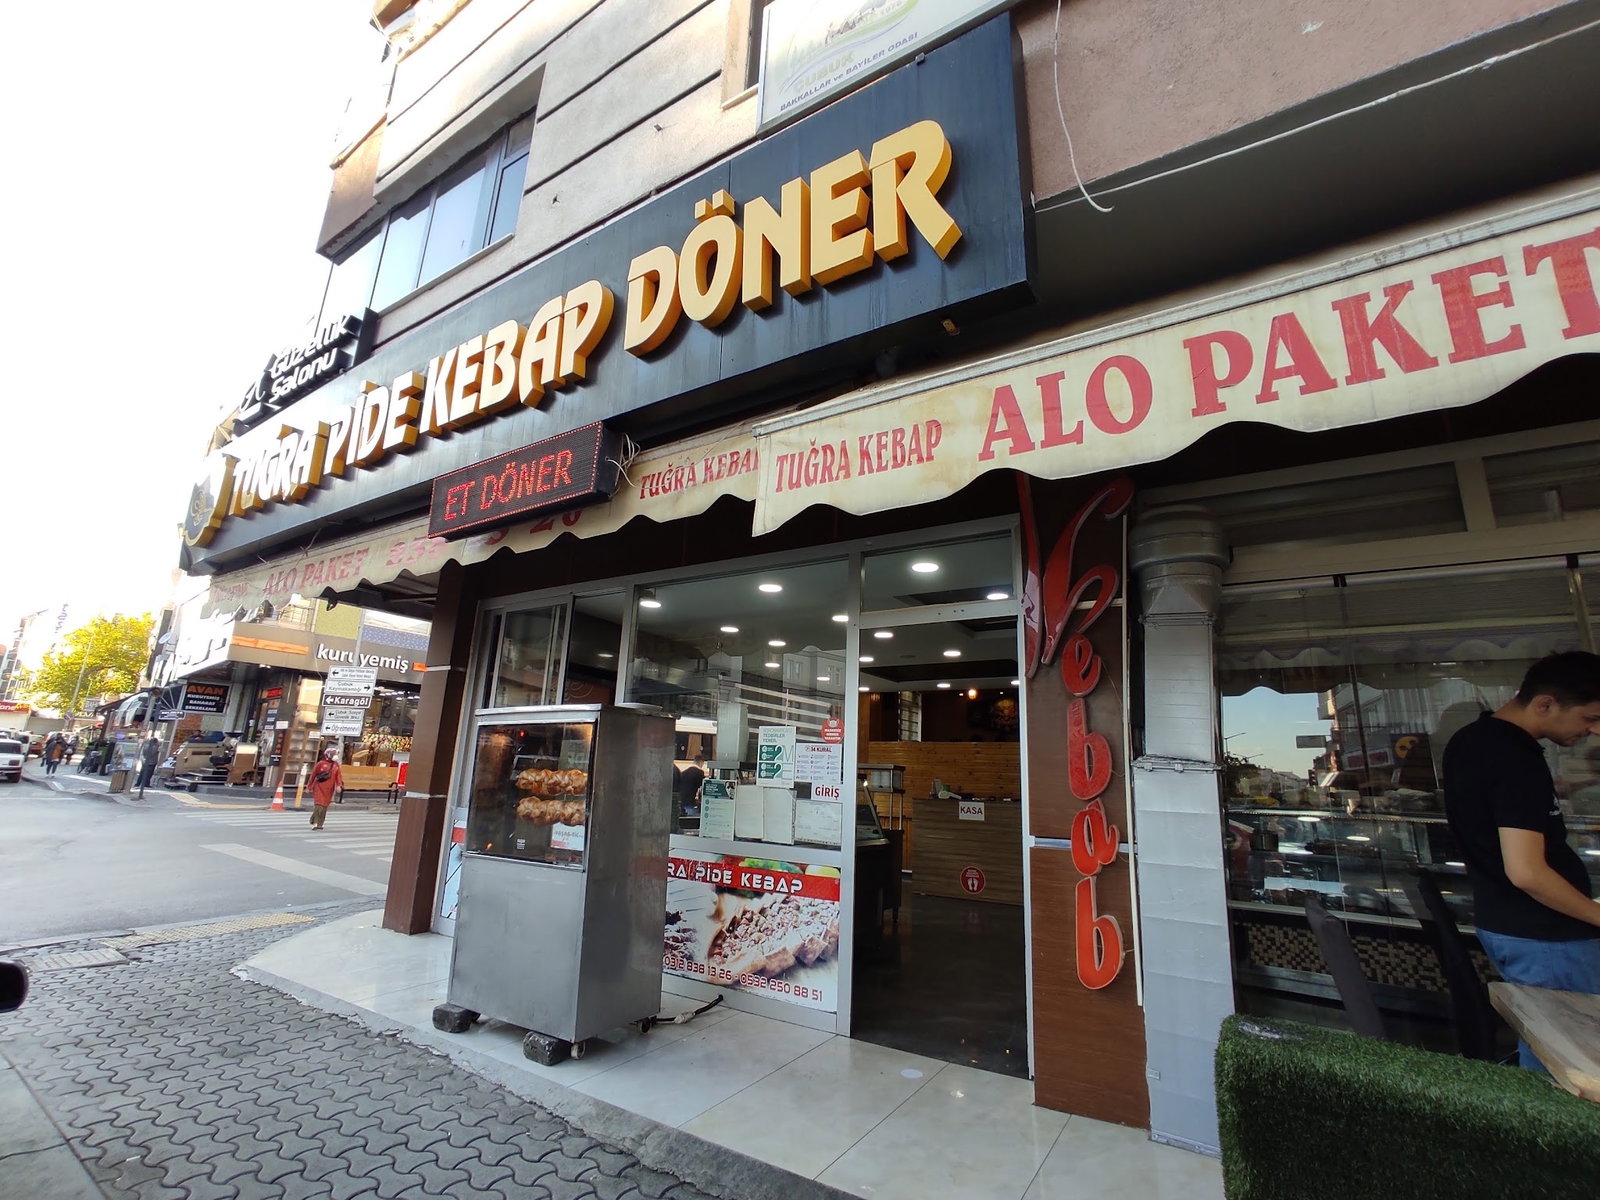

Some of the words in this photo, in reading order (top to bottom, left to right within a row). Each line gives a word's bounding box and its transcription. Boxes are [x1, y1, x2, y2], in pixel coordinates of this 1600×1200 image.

[780, 79, 832, 112] BAKKALLAR
[833, 73, 844, 82] ve
[845, 49, 886, 76] BAYİLER
[887, 32, 919, 53] ODASI
[323, 371, 430, 477] PİDE
[420, 280, 609, 436] KEBAP
[624, 119, 961, 356] DÖNER
[978, 355, 1153, 462] ALO
[1183, 225, 1600, 418] PAKET
[775, 438, 852, 493] TUĞRA
[857, 418, 943, 477] KEBAP
[443, 479, 476, 522] ET
[479, 448, 574, 511] DÖNER
[638, 462, 698, 500] TUĞRA
[261, 568, 297, 598] ALO
[300, 547, 370, 589] PAKET
[187, 685, 224, 696] AVAN
[333, 696, 369, 707] Karagöl
[815, 785, 840, 800] GİRİŞ
[960, 806, 983, 815] KASA
[695, 862, 733, 884] PİDE
[741, 872, 803, 894] KEBAP
[664, 957, 684, 970] 0312
[686, 962, 705, 974] 838
[708, 966, 716, 977] 13
[719, 969, 732, 981] 26
[740, 974, 766, 988] 0532
[770, 979, 790, 994] 250
[793, 984, 809, 1000] 88
[812, 990, 823, 1002] 51
